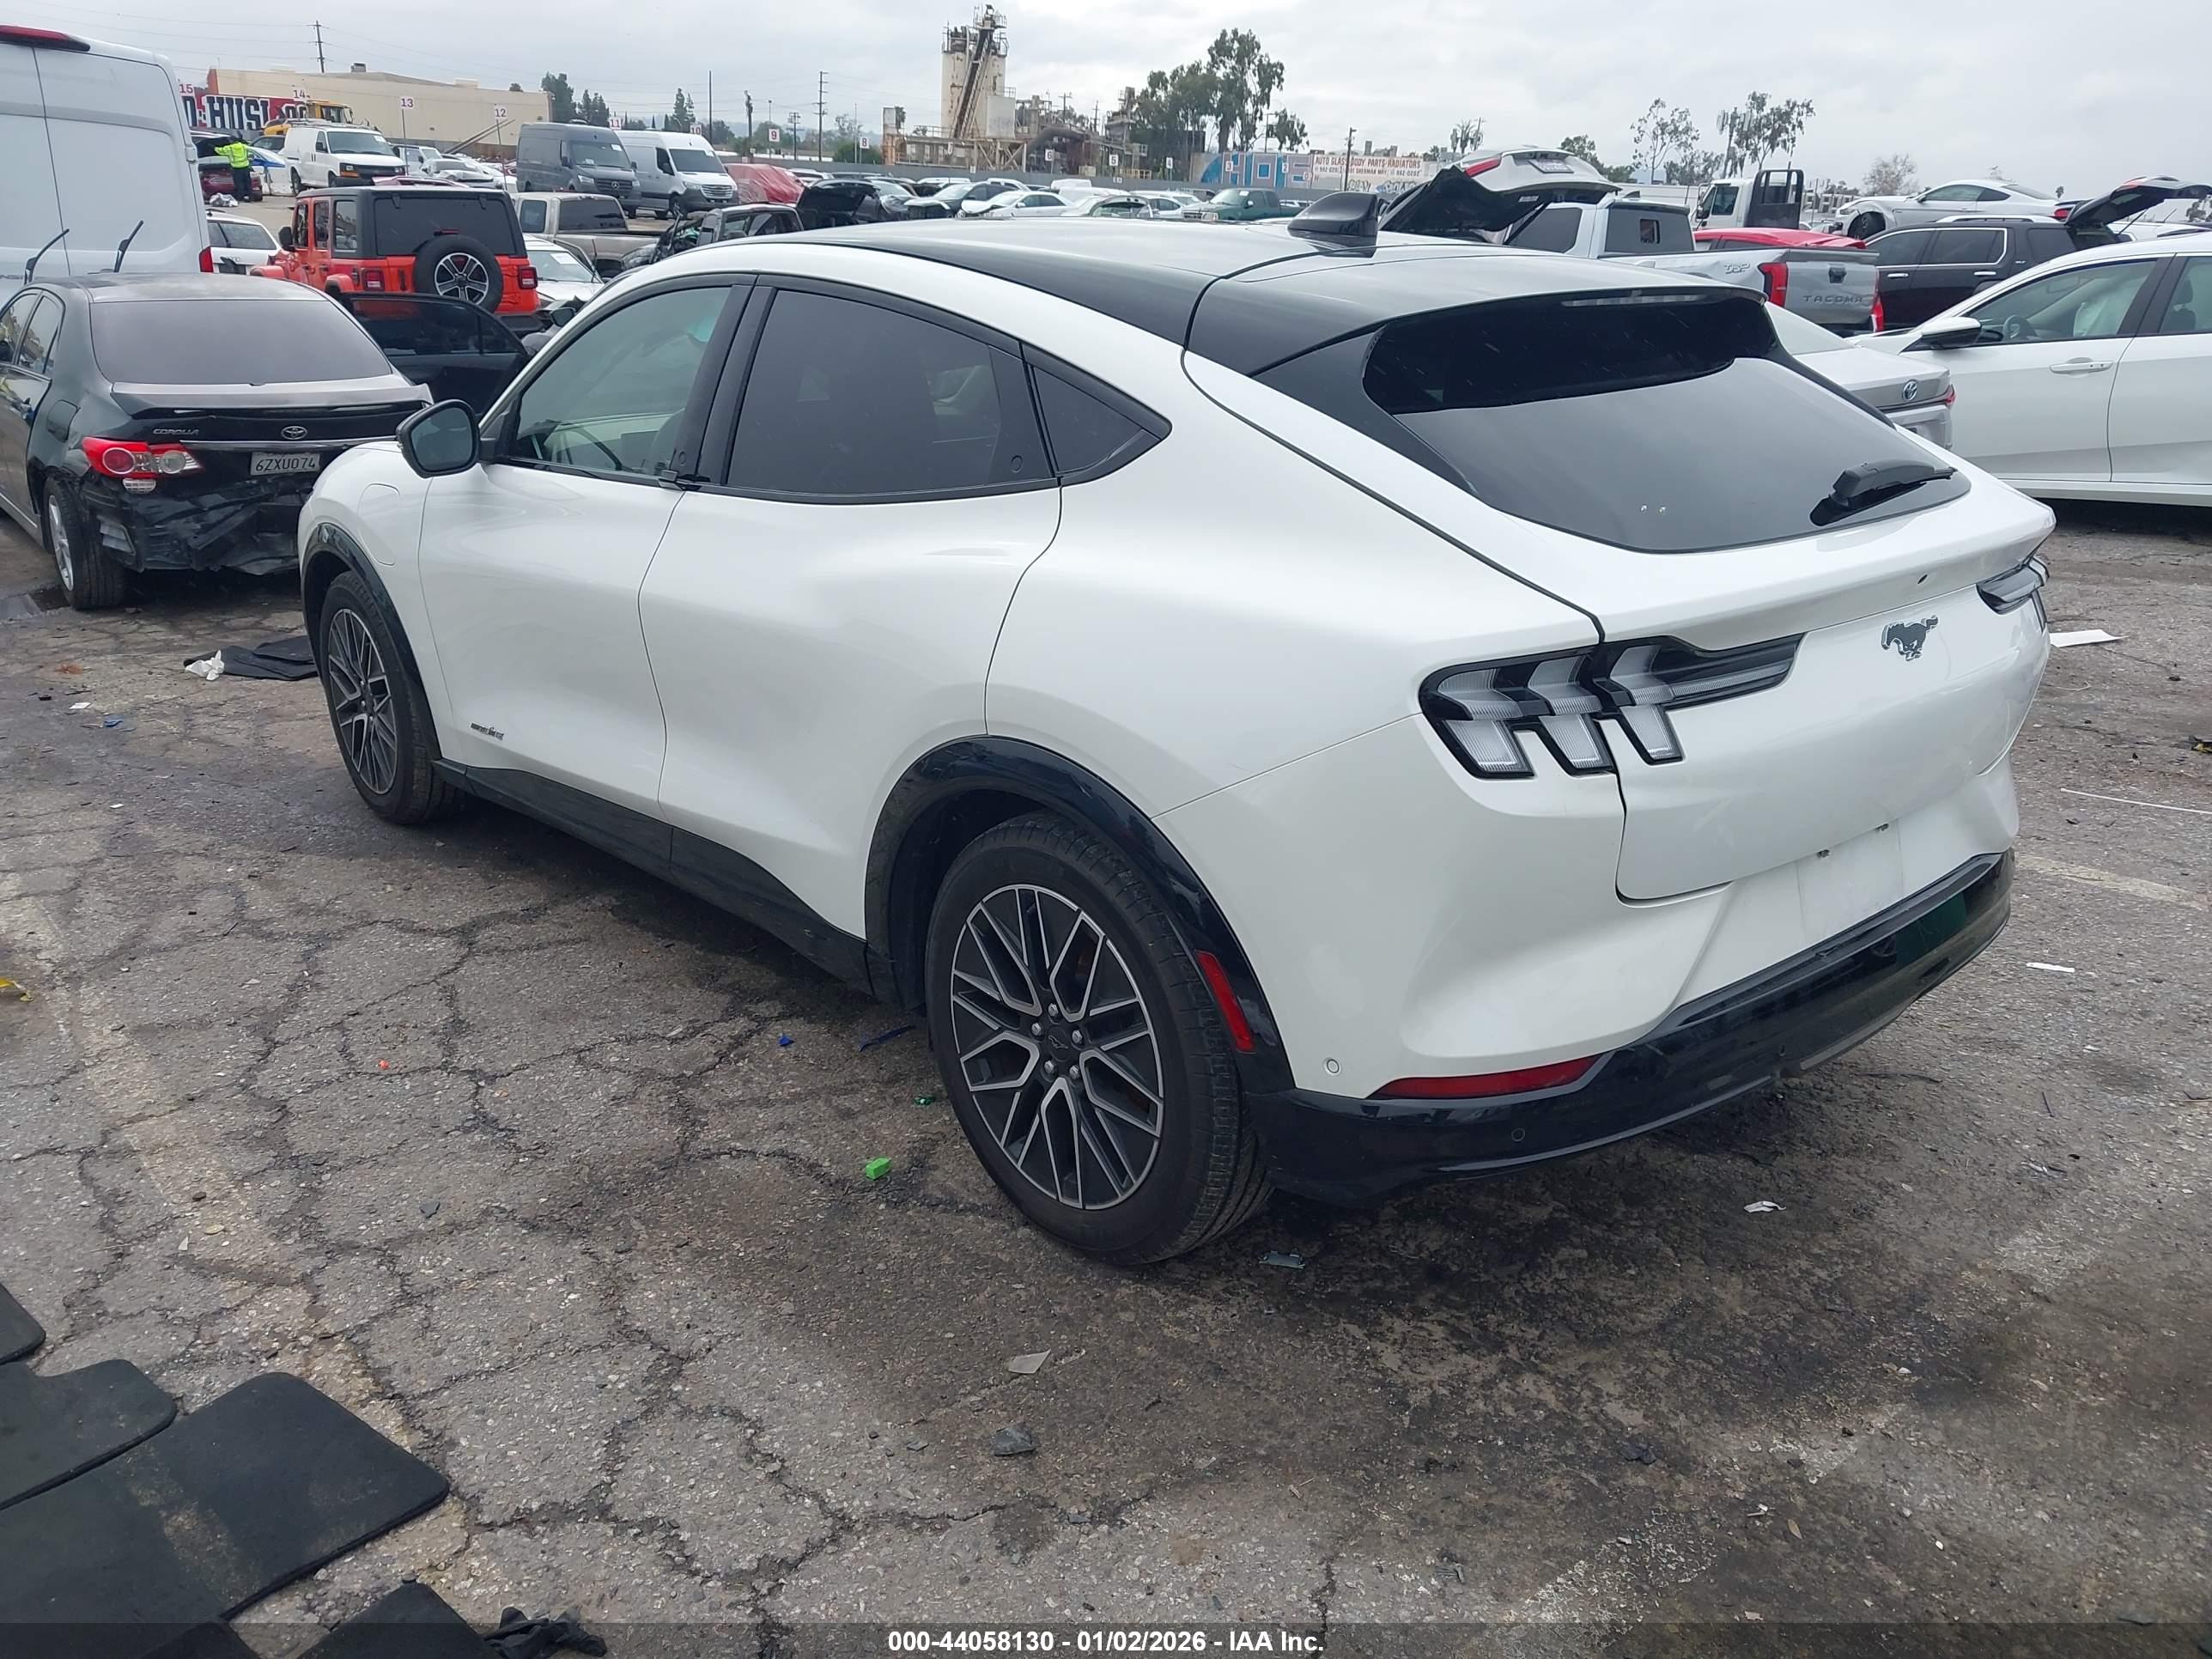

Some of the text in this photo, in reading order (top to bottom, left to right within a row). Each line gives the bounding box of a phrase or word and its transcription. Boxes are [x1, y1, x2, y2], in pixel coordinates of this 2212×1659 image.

[179, 83, 193, 94] 15
[294, 89, 306, 99] 14
[400, 98, 414, 108] 13
[495, 108, 507, 118] 12
[609, 118, 621, 128] 11
[770, 130, 777, 140] 9
[861, 137, 867, 148] 8
[1046, 150, 1053, 161] 6
[1110, 155, 1117, 165] 5
[1802, 295, 1863, 303] TACOMA
[152, 428, 199, 436] COROLLA
[255, 457, 316, 471] 6ZXU074
